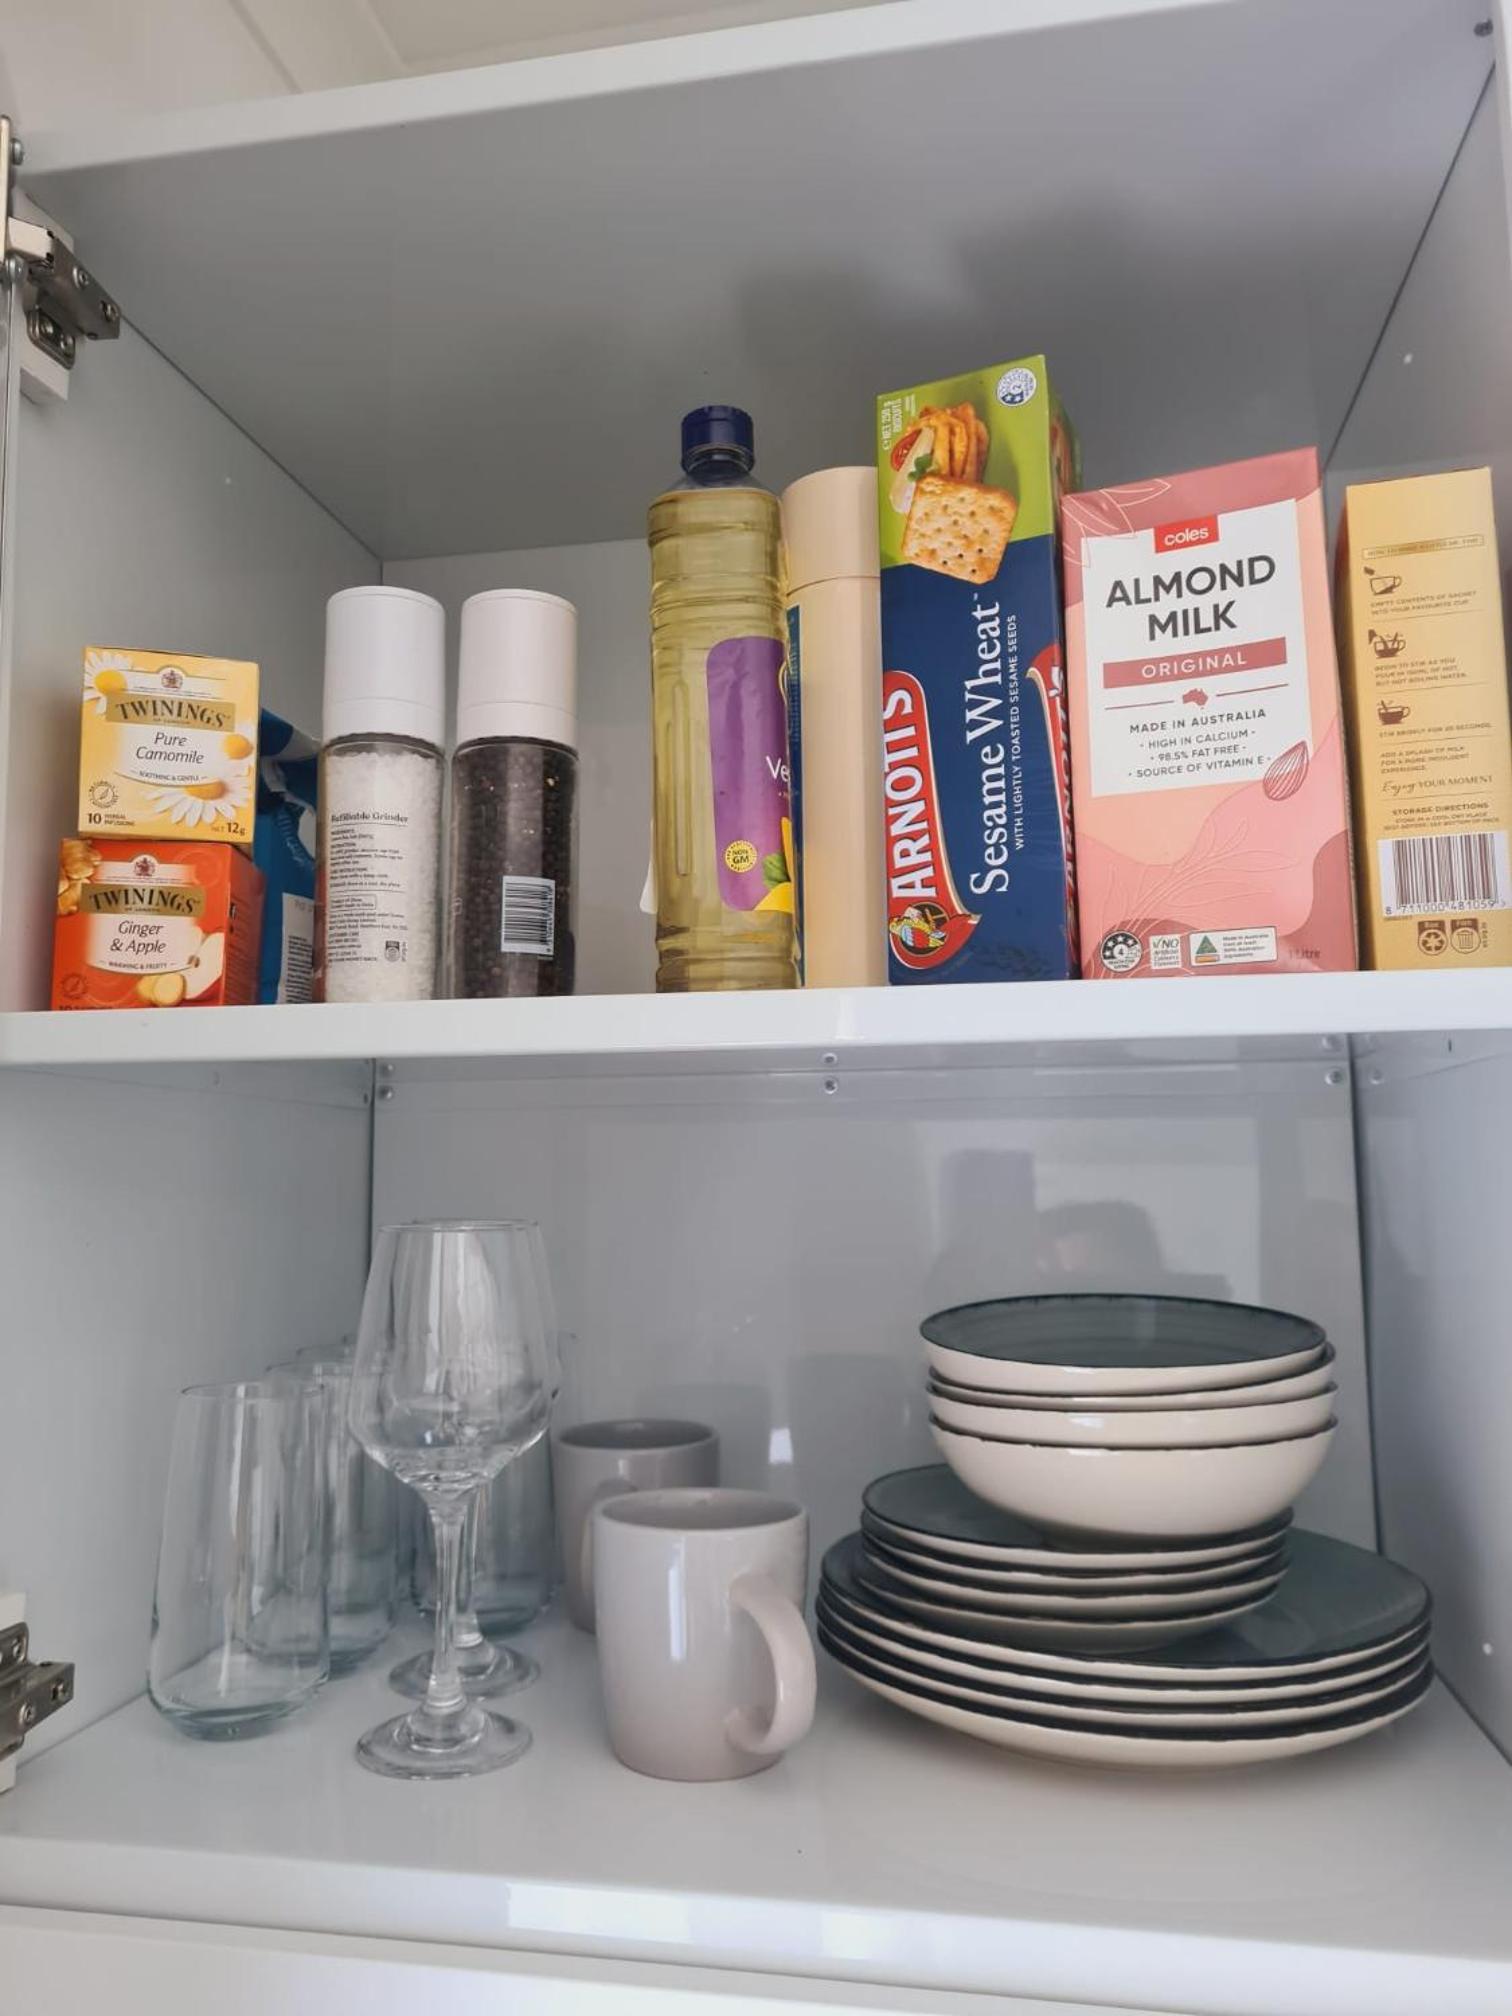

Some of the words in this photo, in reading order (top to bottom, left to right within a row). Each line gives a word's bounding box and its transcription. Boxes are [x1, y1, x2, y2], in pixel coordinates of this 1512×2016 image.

[1164, 527, 1209, 547] coles
[1106, 554, 1276, 608] ALMOND
[1148, 600, 1237, 641] MILK
[1007, 614, 1017, 653] SEEDS
[1141, 652, 1248, 679] ORIGINAL
[1009, 655, 1020, 703] SESAME
[115, 699, 228, 728] TWININGS
[1130, 721, 1167, 734] MADE
[1172, 719, 1186, 729] IN
[1191, 708, 1266, 727] AUSTRALIA
[154, 731, 187, 747] Pure
[1011, 705, 1022, 761] TOASTED
[1148, 737, 1177, 749] HIGH
[1181, 736, 1192, 746] IN
[1196, 729, 1248, 744] CALCIUM
[136, 747, 204, 764] Camomile
[1158, 750, 1189, 762] 98.5%
[1192, 748, 1210, 758] FAT
[1213, 744, 1240, 756] FREE
[1136, 765, 1183, 778] SOURCE
[1186, 763, 1201, 773] OF
[1206, 756, 1253, 771] VITAMIN
[1257, 755, 1264, 765] E
[1418, 779, 1446, 788] YOUR
[1448, 775, 1493, 785] MOMENT
[882, 687, 937, 898] ARNOTTS
[1014, 766, 1024, 822] LIGHTLY
[87, 812, 102, 825] 10
[373, 811, 409, 823] Grinder
[971, 743, 1009, 895] Sesame
[1392, 807, 1432, 816] STORAGE
[1435, 802, 1489, 813] DIRECTIONS
[227, 822, 246, 836] 12g
[1014, 823, 1025, 850] WITH
[732, 855, 750, 864] GM
[89, 887, 197, 914] TWININGS
[118, 920, 164, 938] Ginger
[110, 939, 123, 952] &
[125, 939, 167, 955] Apple
[1118, 947, 1124, 955] 4
